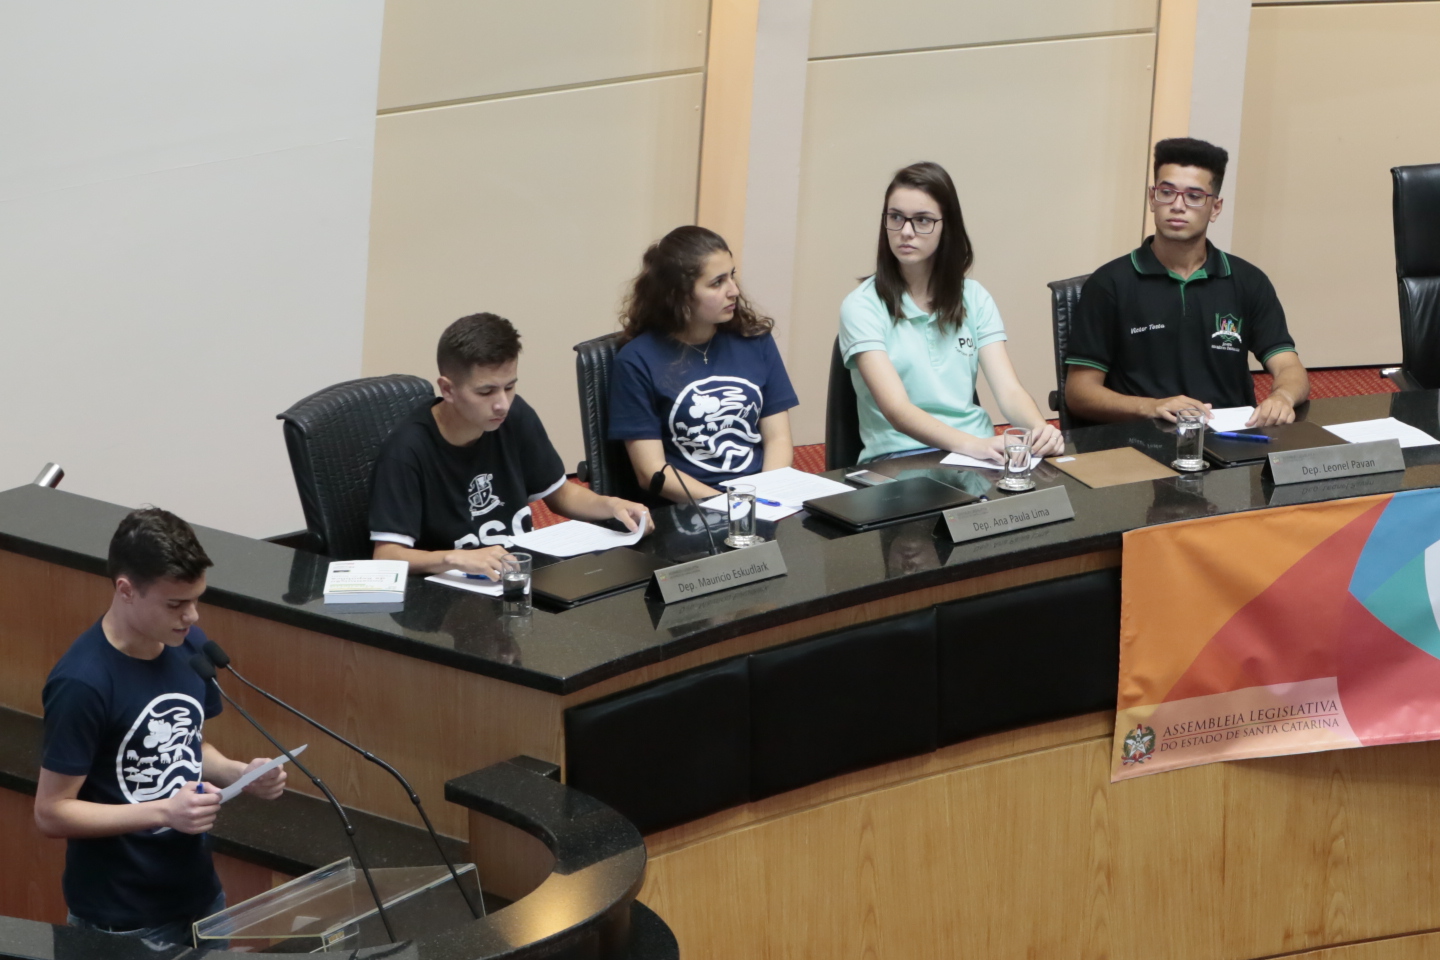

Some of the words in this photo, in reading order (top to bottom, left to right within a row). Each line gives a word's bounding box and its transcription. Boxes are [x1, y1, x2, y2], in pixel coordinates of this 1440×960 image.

[1302, 466, 1322, 477] Dep.
[1323, 461, 1350, 473] Leonel
[1351, 459, 1376, 469] Pavan
[972, 520, 992, 533] Dep.
[993, 517, 1009, 527] Ana
[1009, 511, 1031, 524] Paula
[1031, 508, 1051, 519] Lima
[678, 583, 698, 593] Dep.
[732, 562, 769, 579] Eskudlark
[1162, 712, 1246, 738] ASSEMBLEIA
[1249, 699, 1338, 722] LEGISLATIVA
[1160, 741, 1178, 752] DO
[1181, 733, 1223, 749] ESTADO
[1226, 730, 1240, 741] DE
[1243, 724, 1278, 737] SANTA
[1281, 717, 1340, 734] CATARINA
